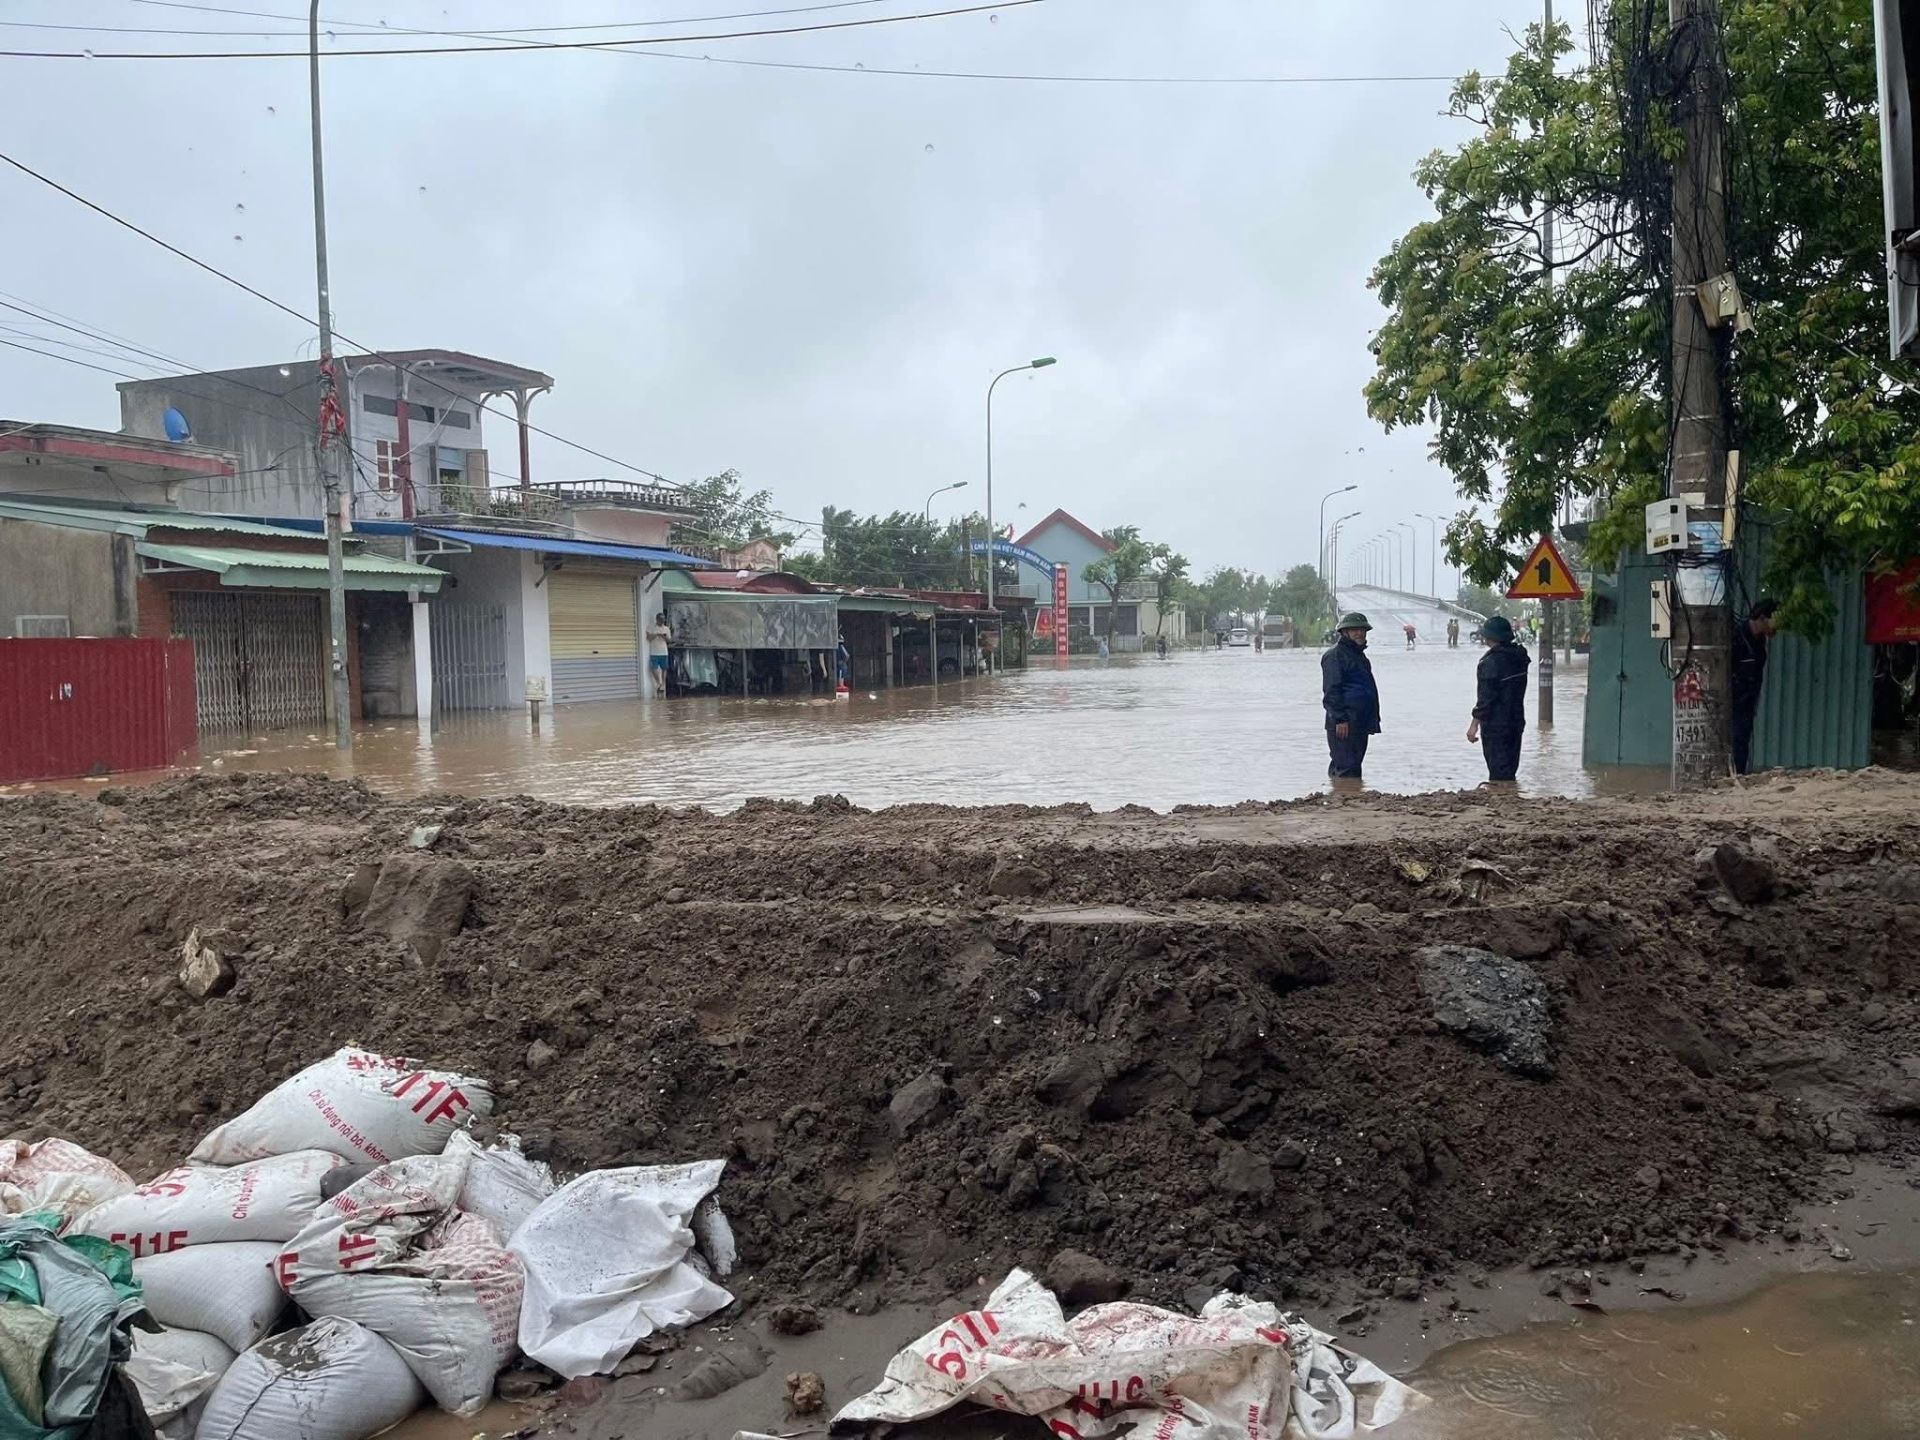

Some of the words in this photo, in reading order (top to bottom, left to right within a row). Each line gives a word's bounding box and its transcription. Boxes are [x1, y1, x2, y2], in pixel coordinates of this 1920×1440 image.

[322, 1106, 342, 1128] dụng
[338, 1122, 357, 1137] nội
[1248, 1404, 1260, 1423] NAM
